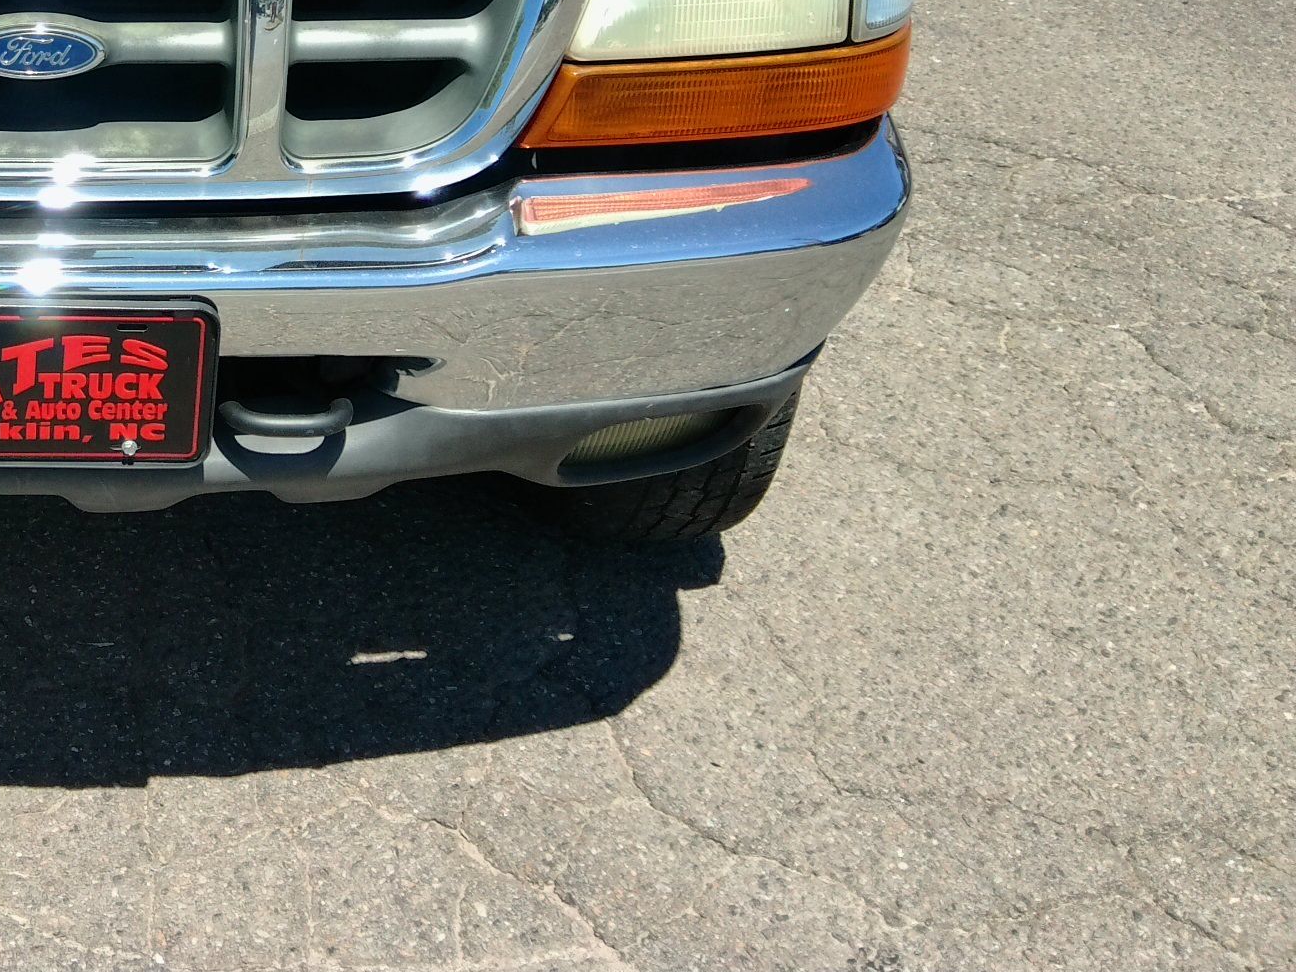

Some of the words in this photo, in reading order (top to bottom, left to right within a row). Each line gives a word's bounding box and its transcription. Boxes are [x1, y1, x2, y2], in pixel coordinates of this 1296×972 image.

[0, 37, 72, 66] Ford
[38, 372, 165, 399] TRUCK
[1, 400, 18, 420] &
[25, 400, 82, 420] Auto
[88, 400, 168, 420] Center
[109, 423, 166, 441] NC
